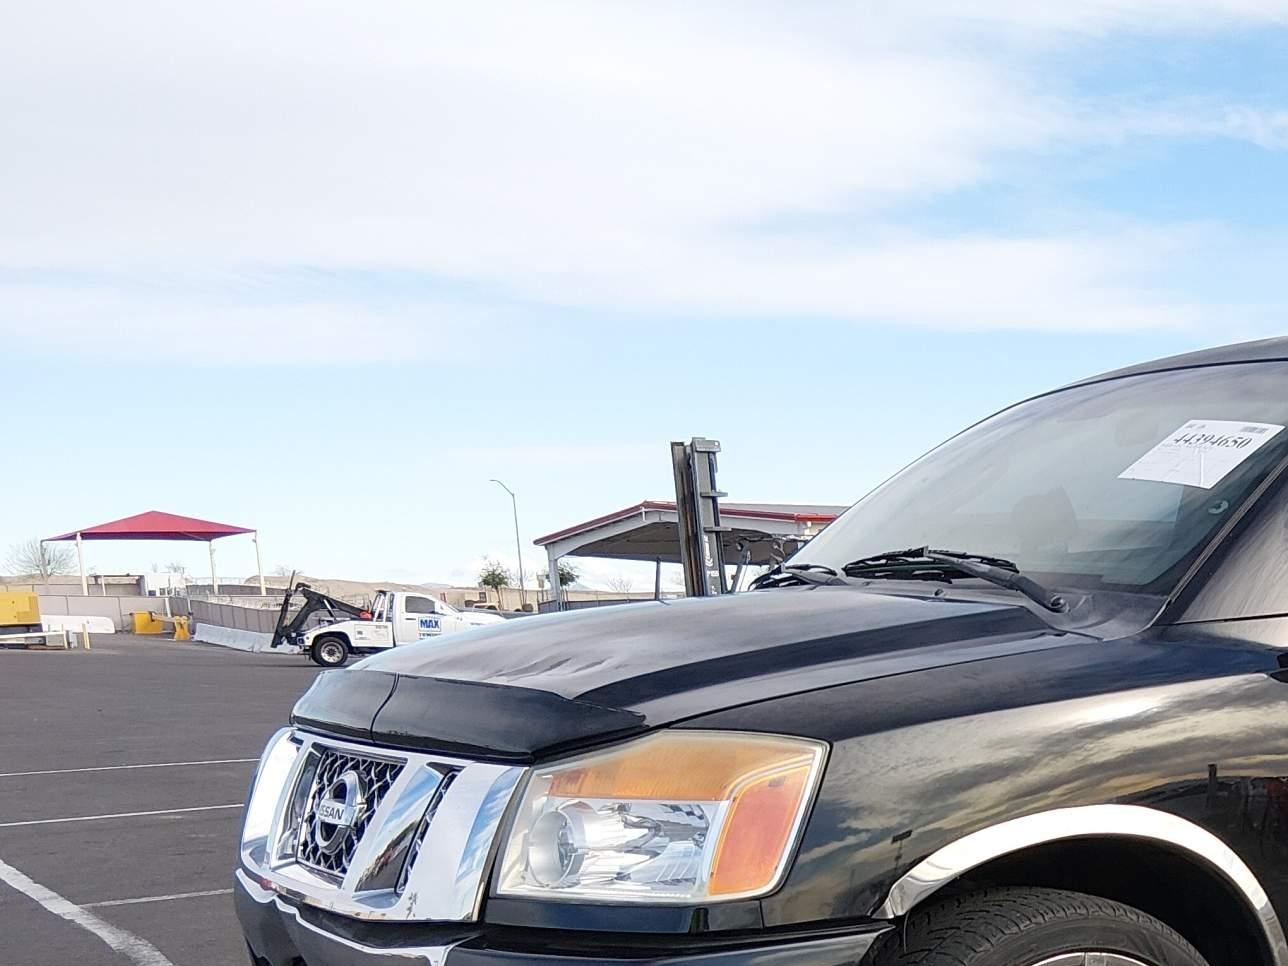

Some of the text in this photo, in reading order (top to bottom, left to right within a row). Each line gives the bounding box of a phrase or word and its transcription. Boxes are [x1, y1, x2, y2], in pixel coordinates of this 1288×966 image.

[1173, 433, 1253, 449] 44394650
[420, 619, 440, 629] MAX
[318, 803, 345, 821] ISSAN
